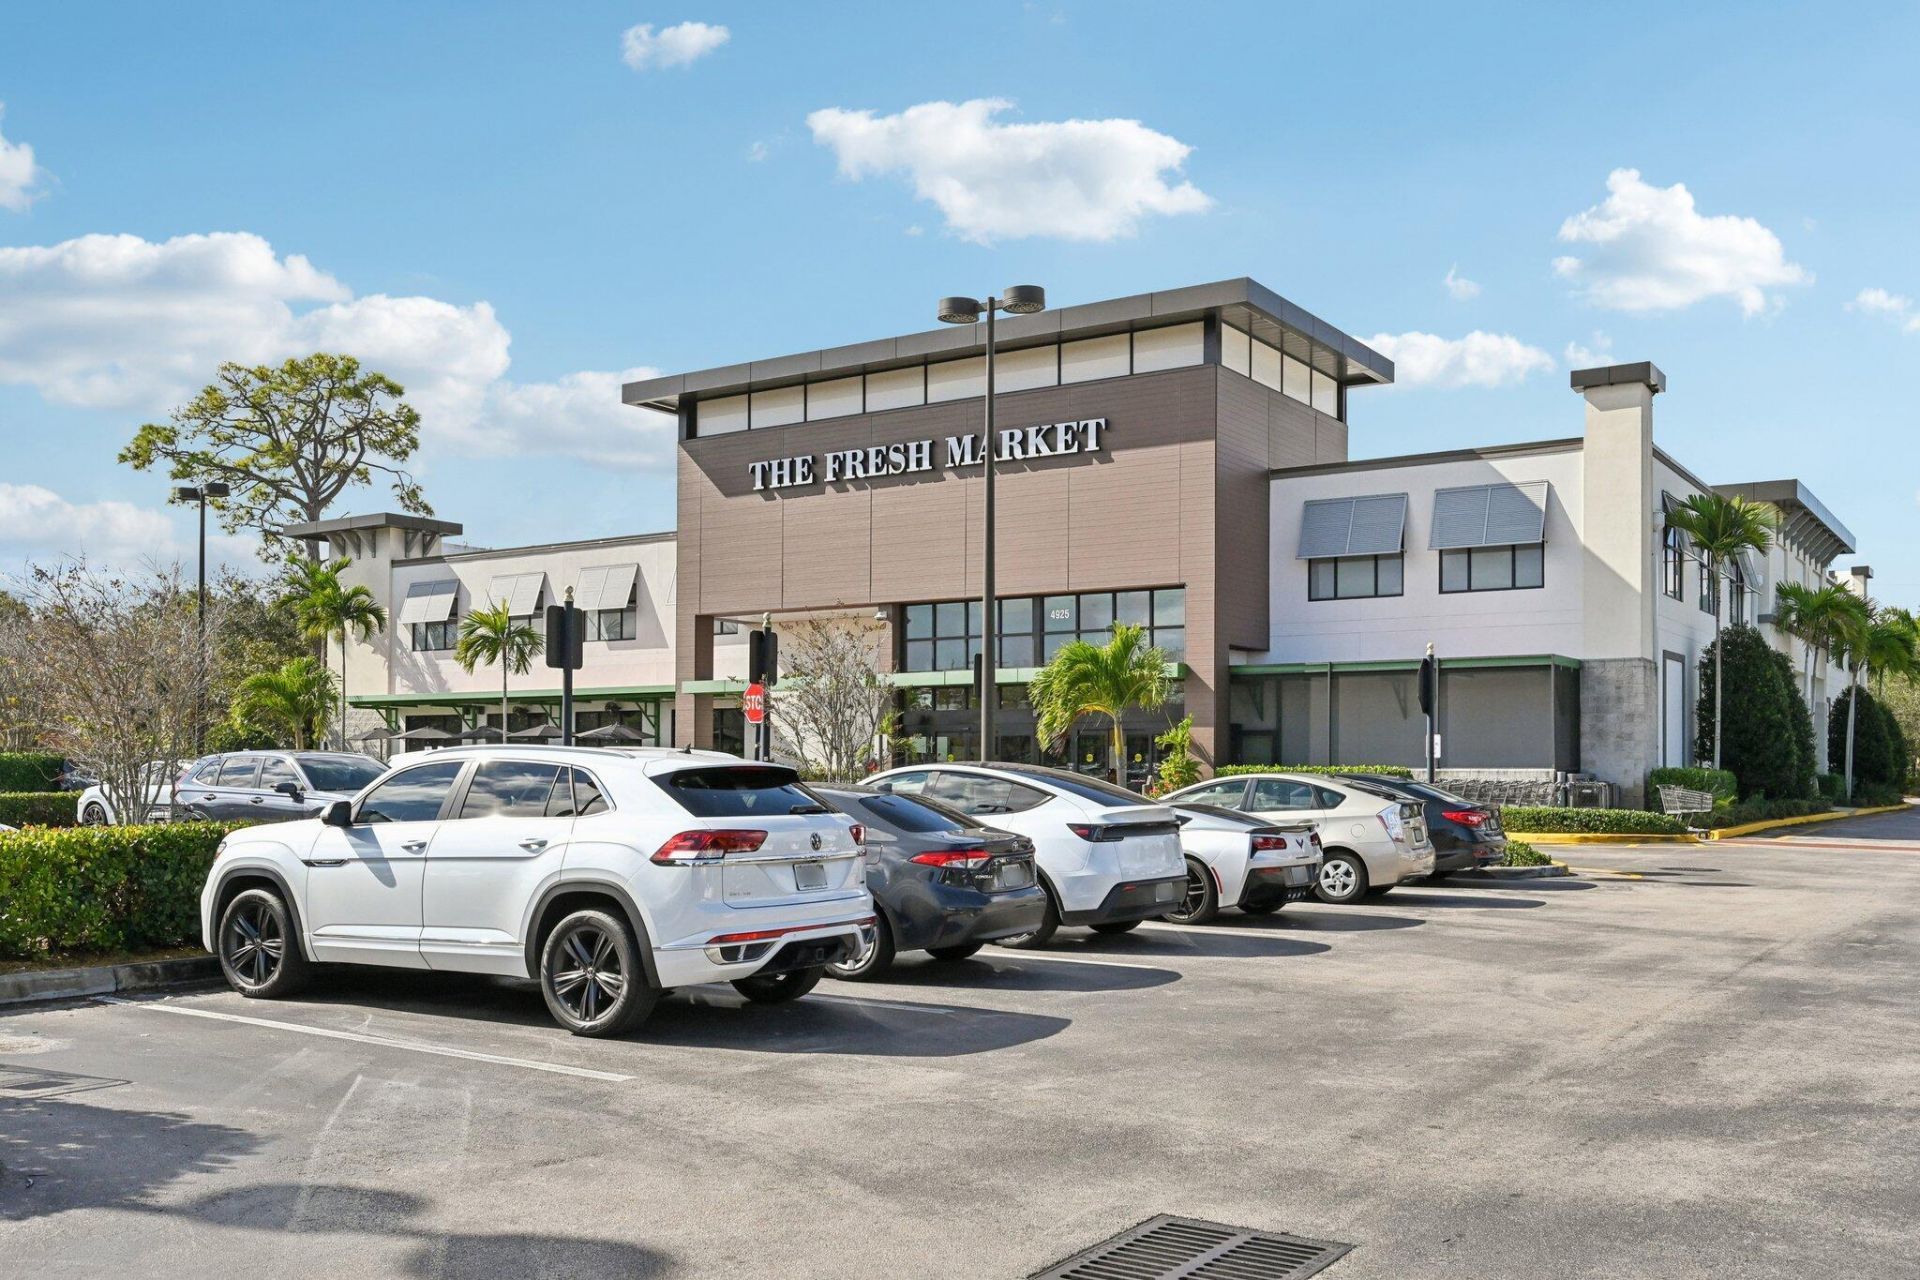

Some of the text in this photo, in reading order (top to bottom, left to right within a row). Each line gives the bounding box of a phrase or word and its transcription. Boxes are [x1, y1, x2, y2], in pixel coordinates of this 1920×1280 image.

[749, 418, 1105, 490] THE FRESH MARKET
[1050, 609, 1070, 619] 4925
[745, 695, 762, 711] STO
